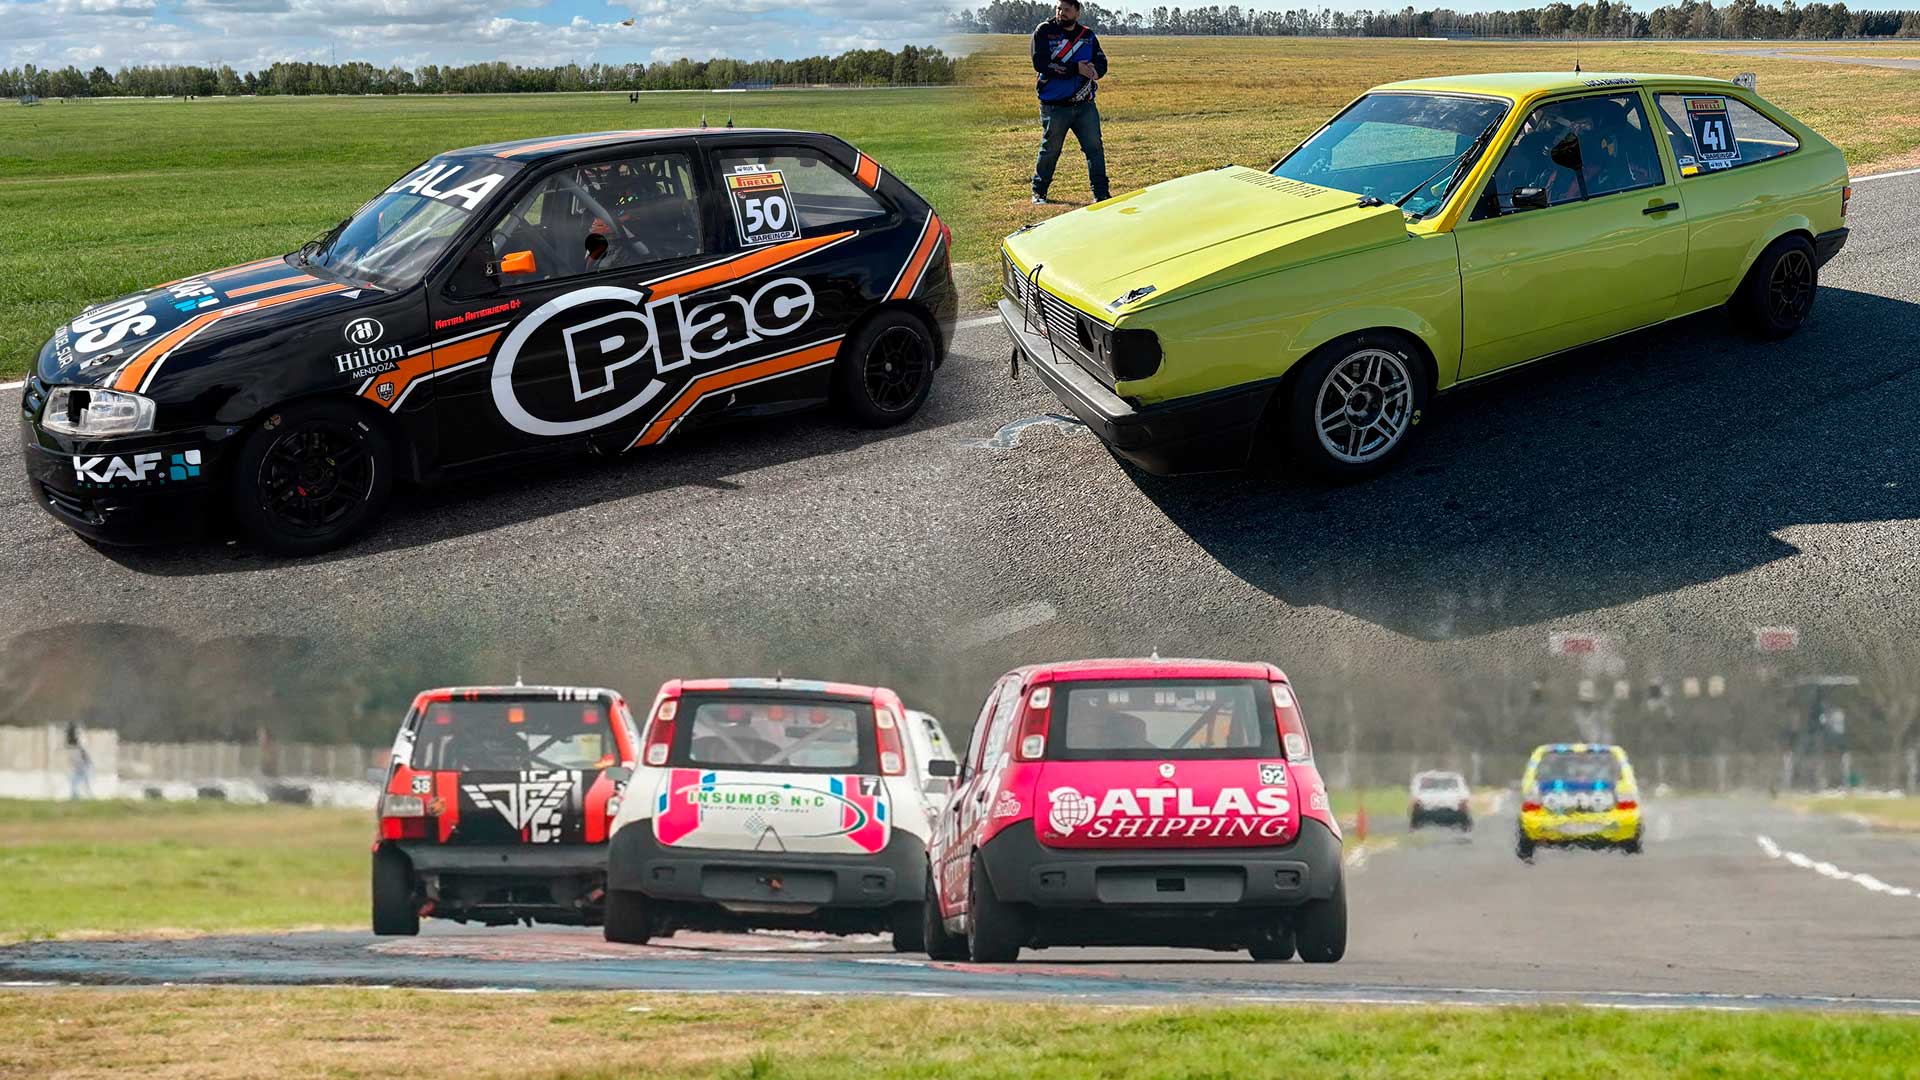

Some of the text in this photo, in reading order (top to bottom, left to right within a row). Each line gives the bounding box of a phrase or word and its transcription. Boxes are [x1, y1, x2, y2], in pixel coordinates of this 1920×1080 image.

[1691, 100, 1720, 110] PIRELLI
[1703, 121, 1726, 150] 41
[736, 174, 775, 187] PIRELLI
[746, 196, 787, 233] 50
[335, 344, 406, 373] Hilton
[352, 361, 396, 379] MENDOZA
[1262, 769, 1286, 784] 92
[412, 780, 430, 793] 38
[863, 781, 876, 795] 7
[689, 792, 781, 806] INSUMOS
[1097, 788, 1291, 816] ATLAS
[1087, 817, 1290, 838] SHIPPING
